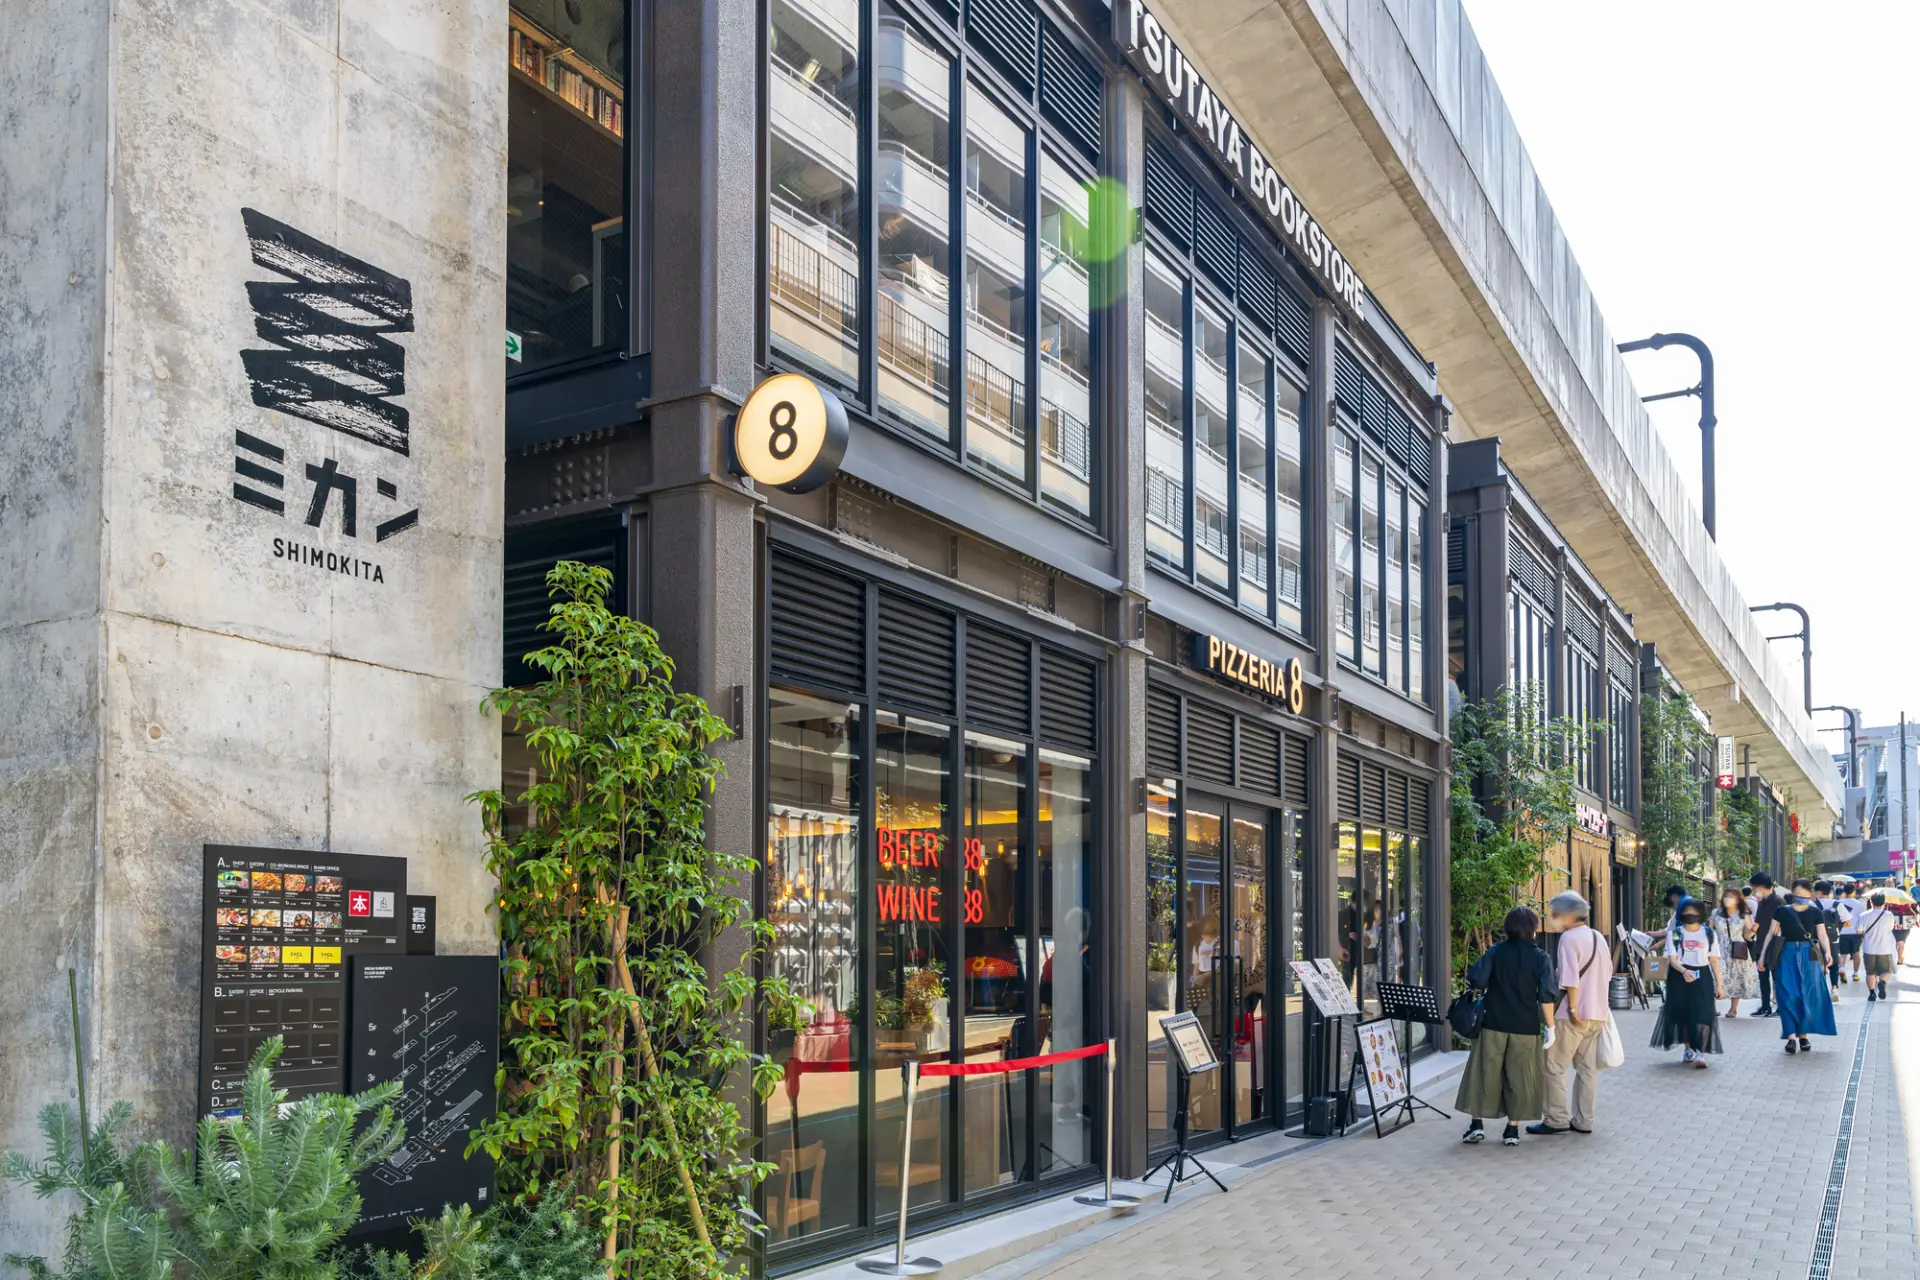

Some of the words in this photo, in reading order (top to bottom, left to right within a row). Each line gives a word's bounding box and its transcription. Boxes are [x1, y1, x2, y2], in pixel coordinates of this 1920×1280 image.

[1128, 0, 1245, 178] TSUTAYA
[1250, 144, 1364, 319] BOOKSTORE
[768, 400, 798, 460] 8
[233, 429, 418, 543] ミカン
[273, 538, 384, 584] SHIMOKITA
[1209, 634, 1286, 700] PIZZERIA
[1290, 656, 1303, 714] 8
[877, 827, 939, 868] BEER
[353, 895, 367, 912] 本
[877, 884, 941, 922] WINE
